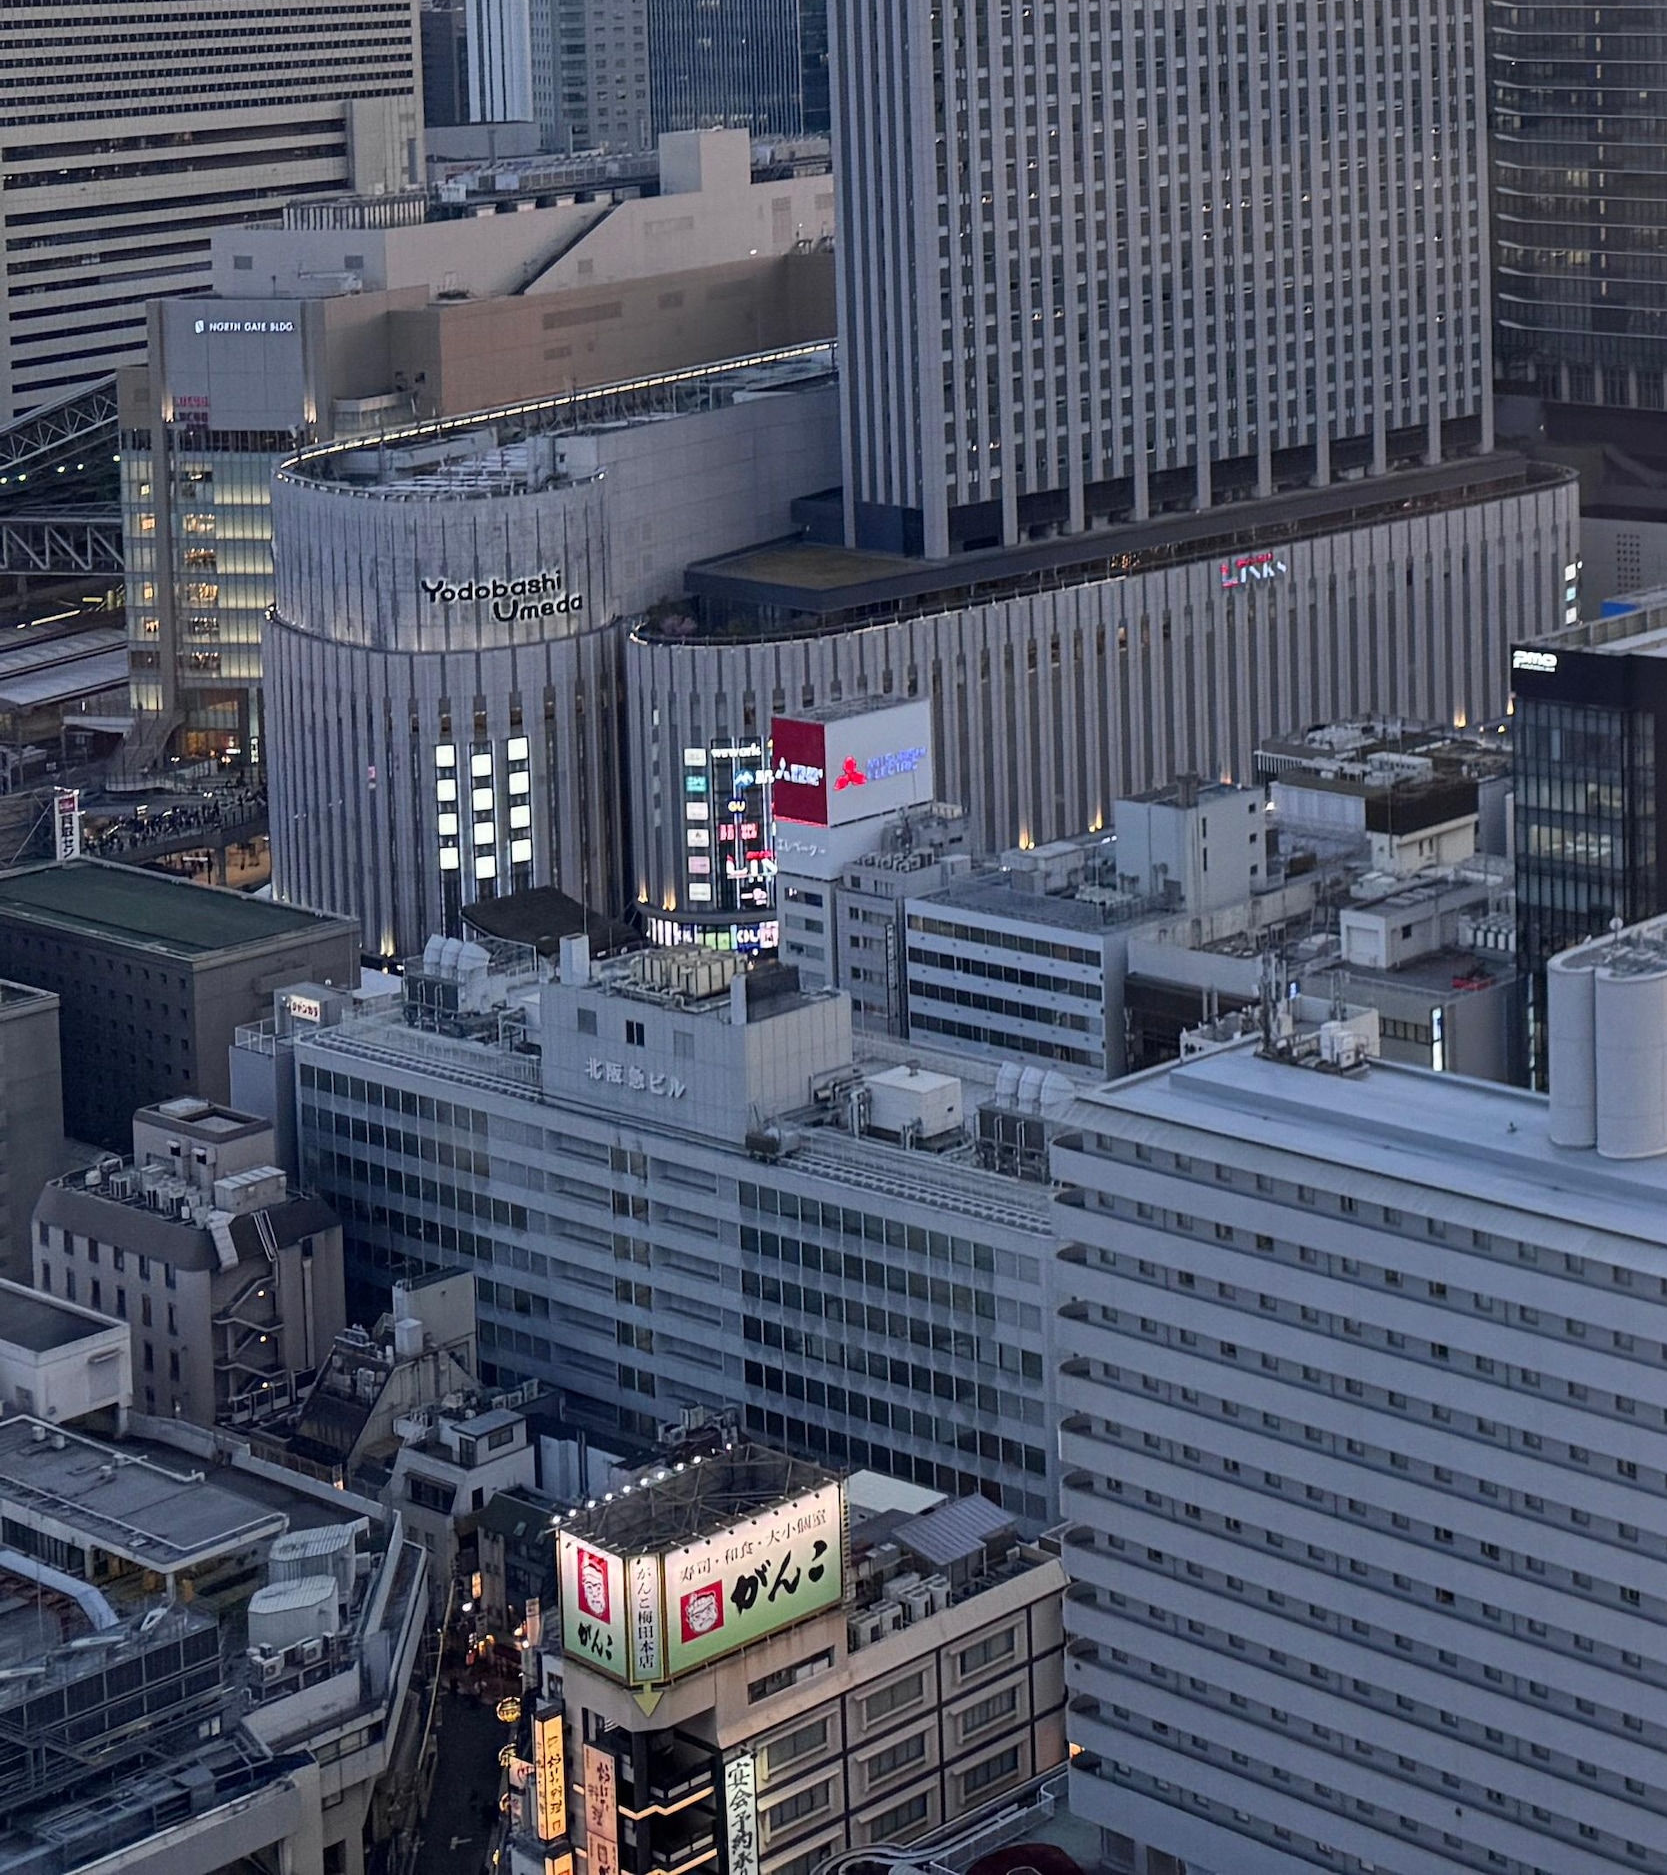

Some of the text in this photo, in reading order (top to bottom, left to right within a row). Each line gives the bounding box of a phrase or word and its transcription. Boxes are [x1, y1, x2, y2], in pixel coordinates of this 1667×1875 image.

[209, 321, 241, 332] NORTH
[244, 321, 267, 332] GATE
[420, 569, 562, 603] Yodobashi
[493, 593, 583, 622] Umeda
[585, 1057, 687, 1099] 北阪急ビル
[730, 1540, 828, 1618] がんこ
[636, 1565, 655, 1670] がんこ梅田本店
[577, 1621, 614, 1662] がんこ
